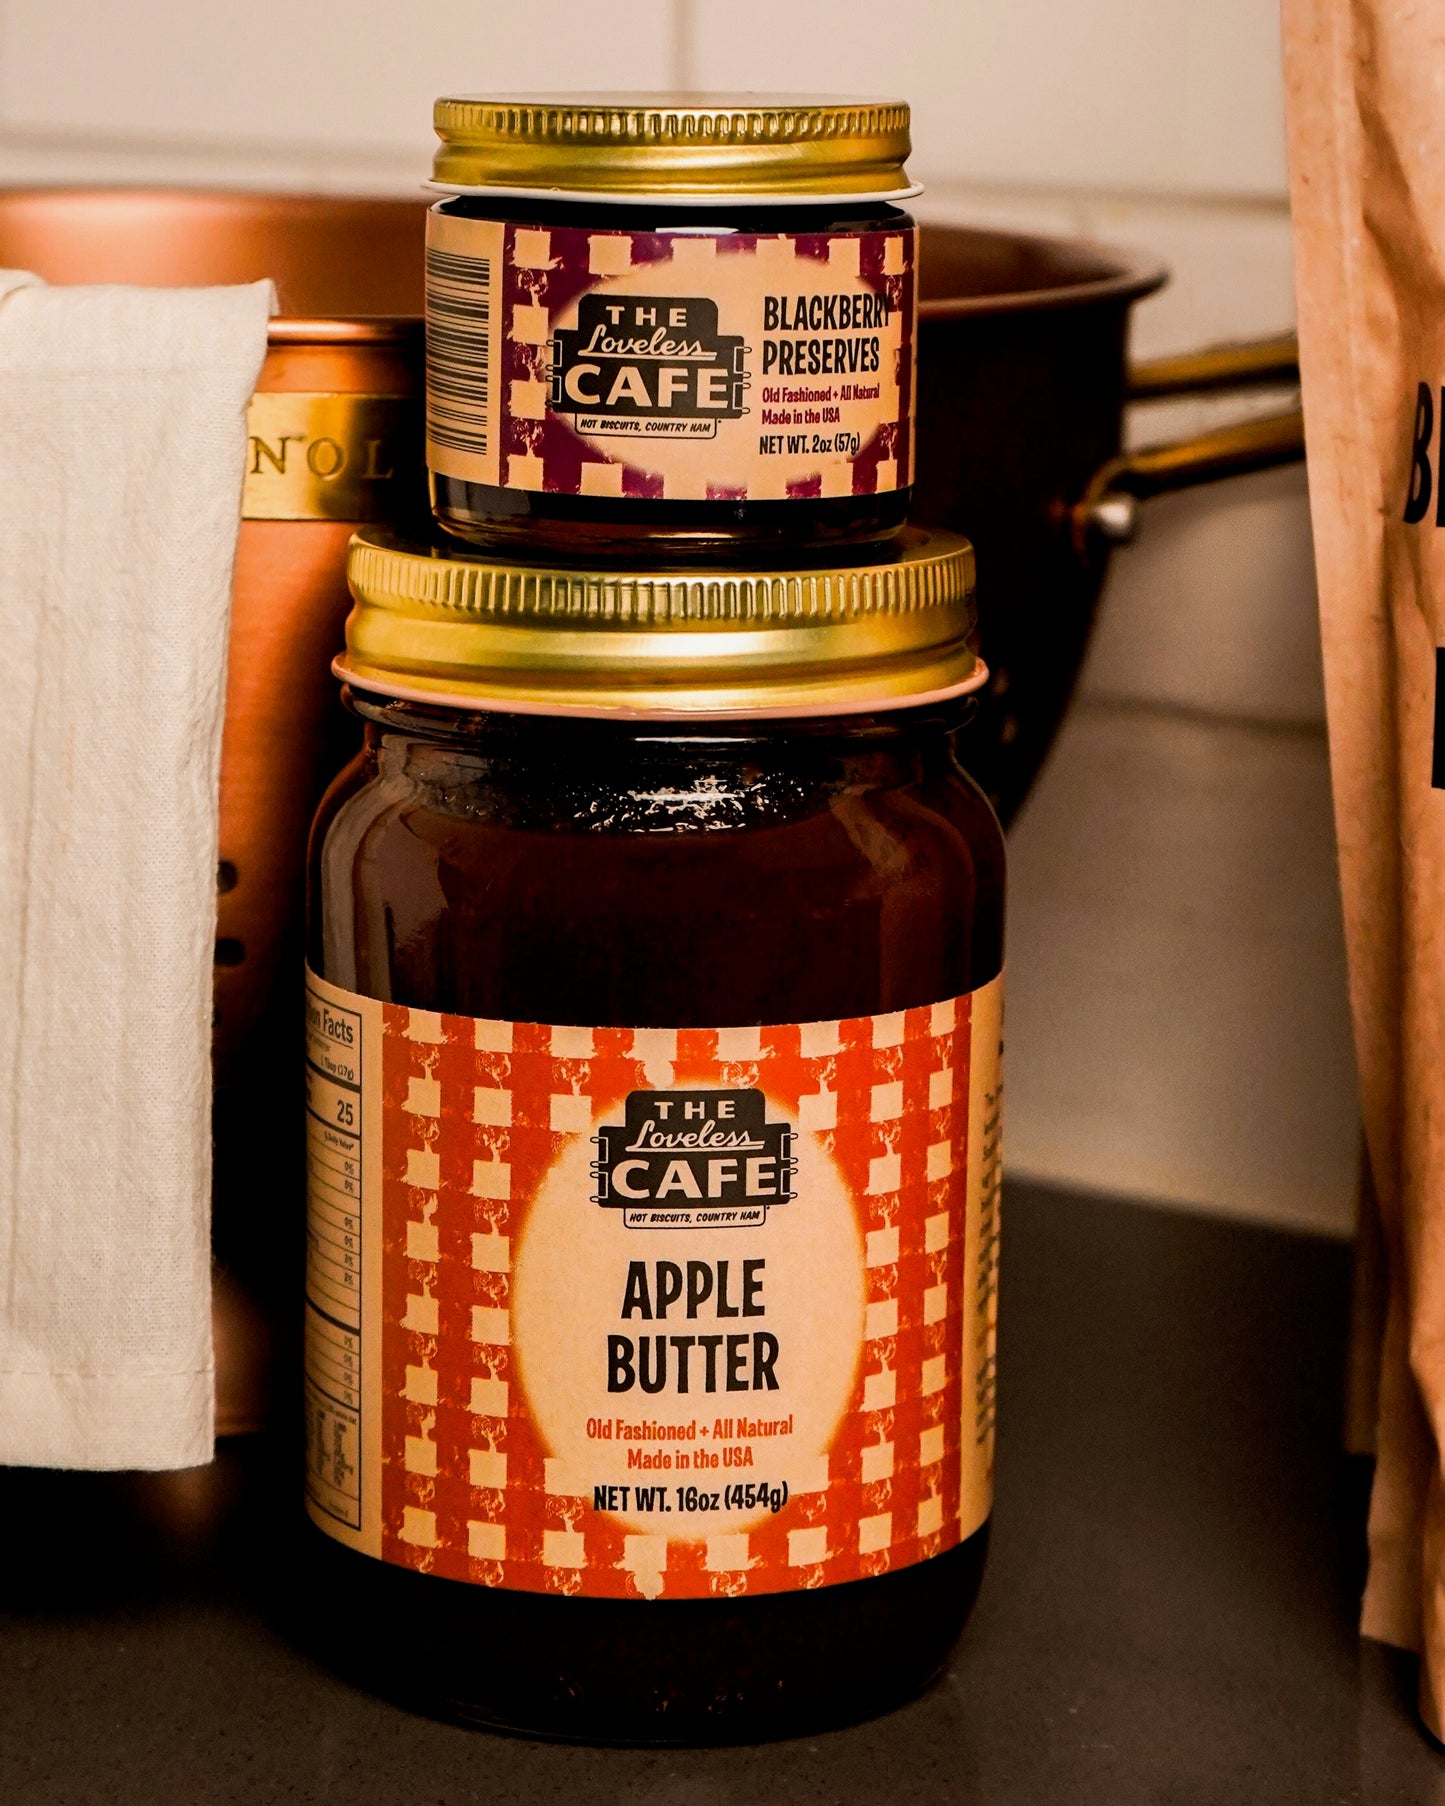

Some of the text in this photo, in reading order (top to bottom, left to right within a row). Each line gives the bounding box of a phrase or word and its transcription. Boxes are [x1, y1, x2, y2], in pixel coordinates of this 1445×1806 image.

[606, 306, 687, 327] THE
[763, 292, 890, 331] BLACKBERRY
[577, 324, 717, 361] Loveless
[762, 336, 880, 376] PRESERVES
[565, 363, 729, 409] CAFE
[762, 387, 780, 403] Old
[782, 386, 831, 403] Fashioned
[840, 385, 851, 400] All
[853, 383, 880, 400] Natural
[580, 419, 711, 433] HOT BISCUITS, COUNTRY HAM
[762, 407, 840, 424] Made in the USA
[760, 432, 860, 456] NET WT. 2oz (57g)
[323, 1008, 353, 1043] Facts
[337, 1099, 353, 1126] 25
[654, 1100, 736, 1120] THE
[625, 1119, 765, 1153] Loveless
[611, 1156, 777, 1200] CAFE
[630, 1213, 648, 1223] HOT
[696, 1212, 738, 1222] COUNTRY
[740, 1211, 760, 1221] HAM
[621, 1258, 766, 1320] APPLE
[607, 1331, 780, 1394] BUTTER
[586, 1417, 612, 1440] Old
[616, 1419, 696, 1440] Fashioned
[713, 1418, 733, 1440] All
[737, 1414, 793, 1438] Natural
[627, 1446, 754, 1470] Made in the USA
[594, 1481, 789, 1514] NET WT. 16oz (454g)
